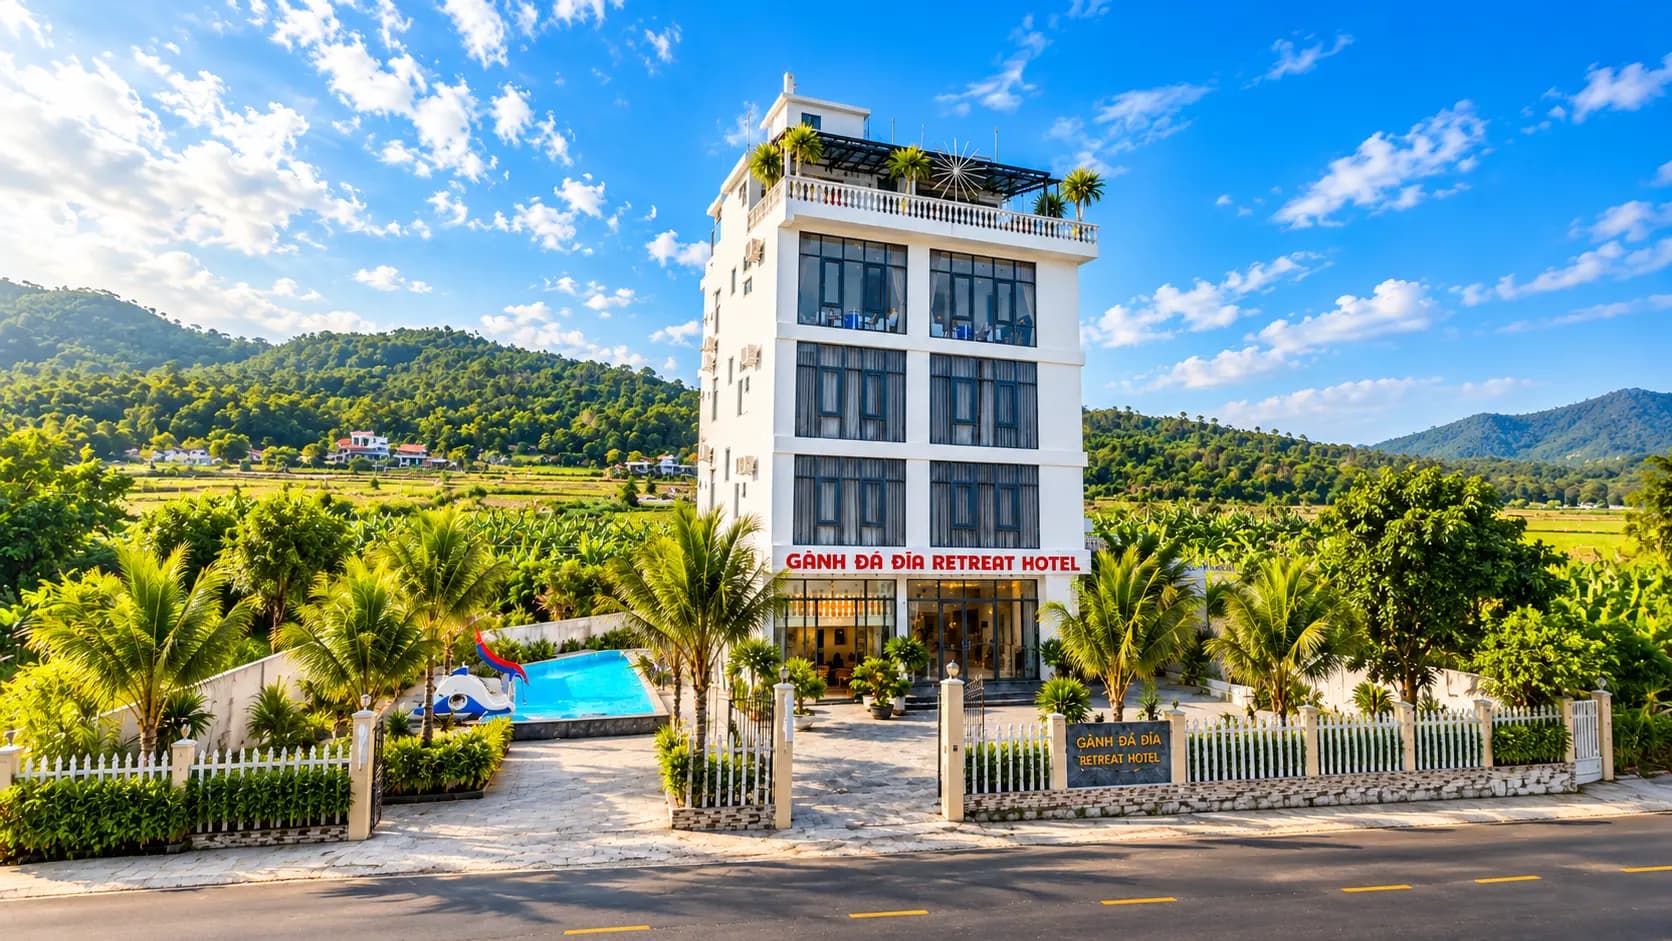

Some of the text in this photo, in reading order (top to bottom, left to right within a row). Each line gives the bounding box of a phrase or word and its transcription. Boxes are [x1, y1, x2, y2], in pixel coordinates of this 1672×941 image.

[854, 551, 883, 570] ĐÁ
[932, 554, 1015, 571] RETREAT
[1022, 555, 1080, 571] HOTEL
[1076, 733, 1114, 749] GÀNH
[1079, 752, 1161, 766] RETREAT HOTEL
